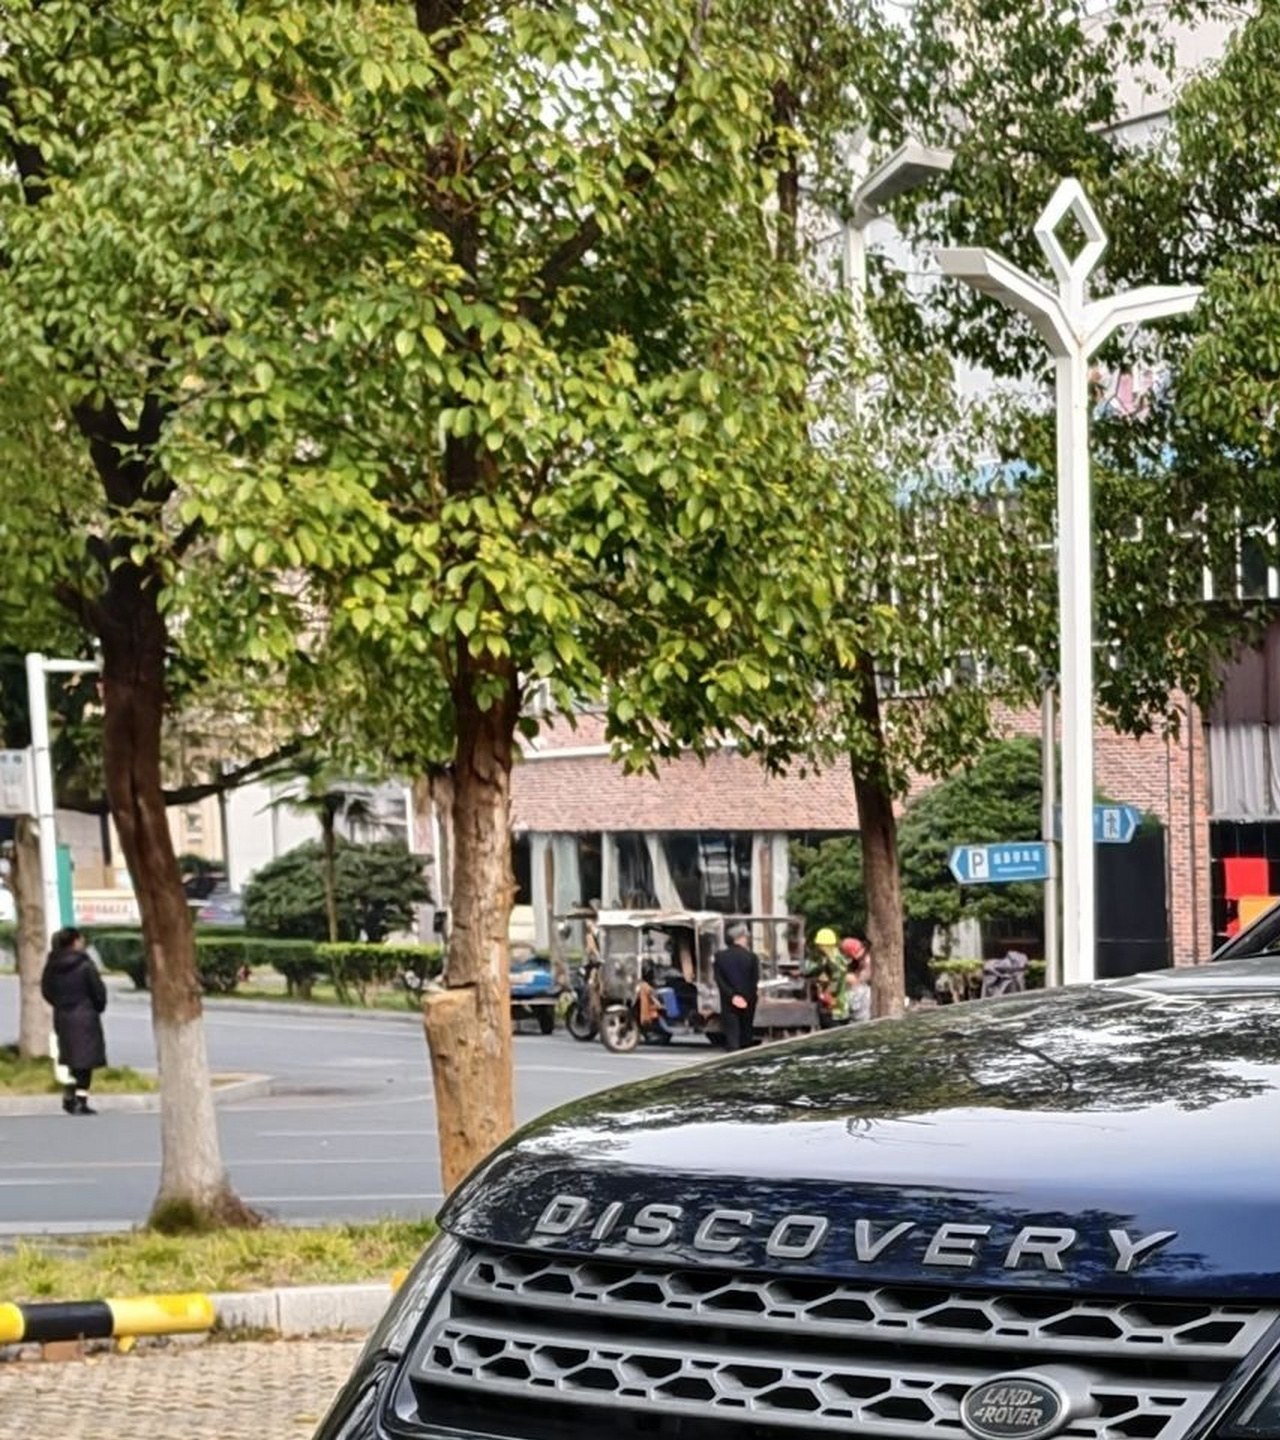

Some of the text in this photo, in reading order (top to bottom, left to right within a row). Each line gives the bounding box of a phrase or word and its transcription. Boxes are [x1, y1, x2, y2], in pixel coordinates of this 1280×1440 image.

[972, 852, 984, 875] P
[535, 1195, 1178, 1273] DISCOVERY
[982, 1387, 1033, 1406] LAND
[981, 1406, 1044, 1426] ROVER
